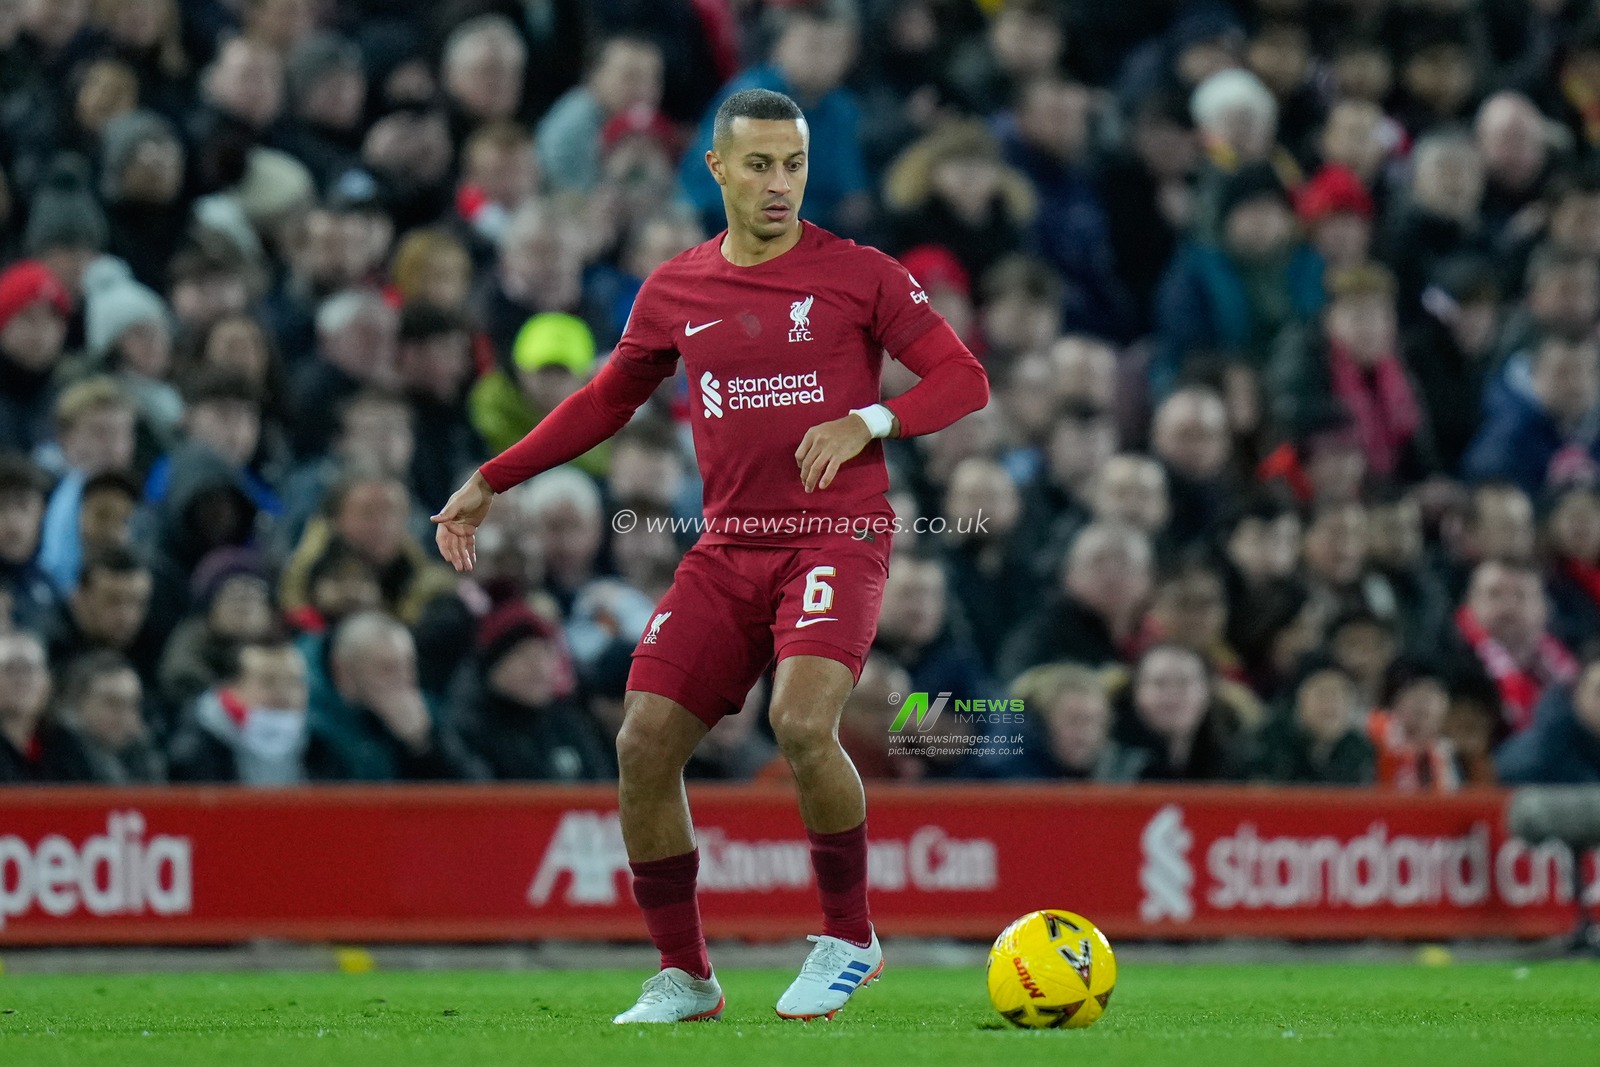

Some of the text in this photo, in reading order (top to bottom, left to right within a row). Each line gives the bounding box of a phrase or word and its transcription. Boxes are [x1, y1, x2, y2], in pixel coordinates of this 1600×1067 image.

[727, 371, 818, 393] standard
[728, 386, 825, 410] chartered
[803, 566, 837, 614] 6
[908, 825, 998, 891] Can
[1206, 822, 1492, 909] standard
